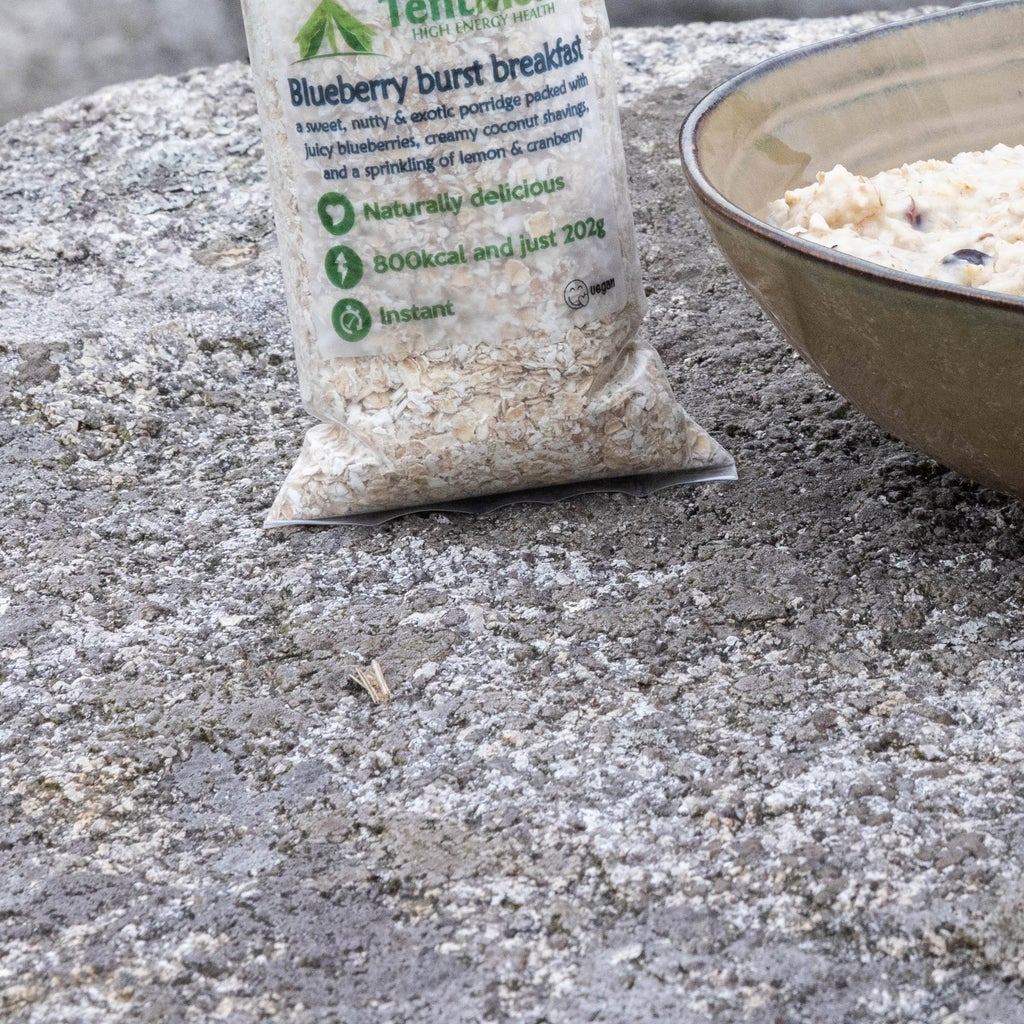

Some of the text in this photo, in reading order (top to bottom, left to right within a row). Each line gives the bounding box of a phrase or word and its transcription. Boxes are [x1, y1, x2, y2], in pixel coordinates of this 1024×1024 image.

[412, 3, 556, 40] HIGH ENERGY HEALTH
[288, 35, 584, 107] Blueberry burst breakfast
[296, 73, 588, 133] a sweet, nutty & exotic porridge packed with
[304, 100, 589, 160] juicy blueberries, creamy coconut shavings,
[323, 128, 583, 182] and a sprinkling of lemon & cranberry
[363, 175, 565, 221] Naturally delicious
[373, 216, 606, 274] 800kcal and just 202g
[380, 301, 455, 325] Instant
